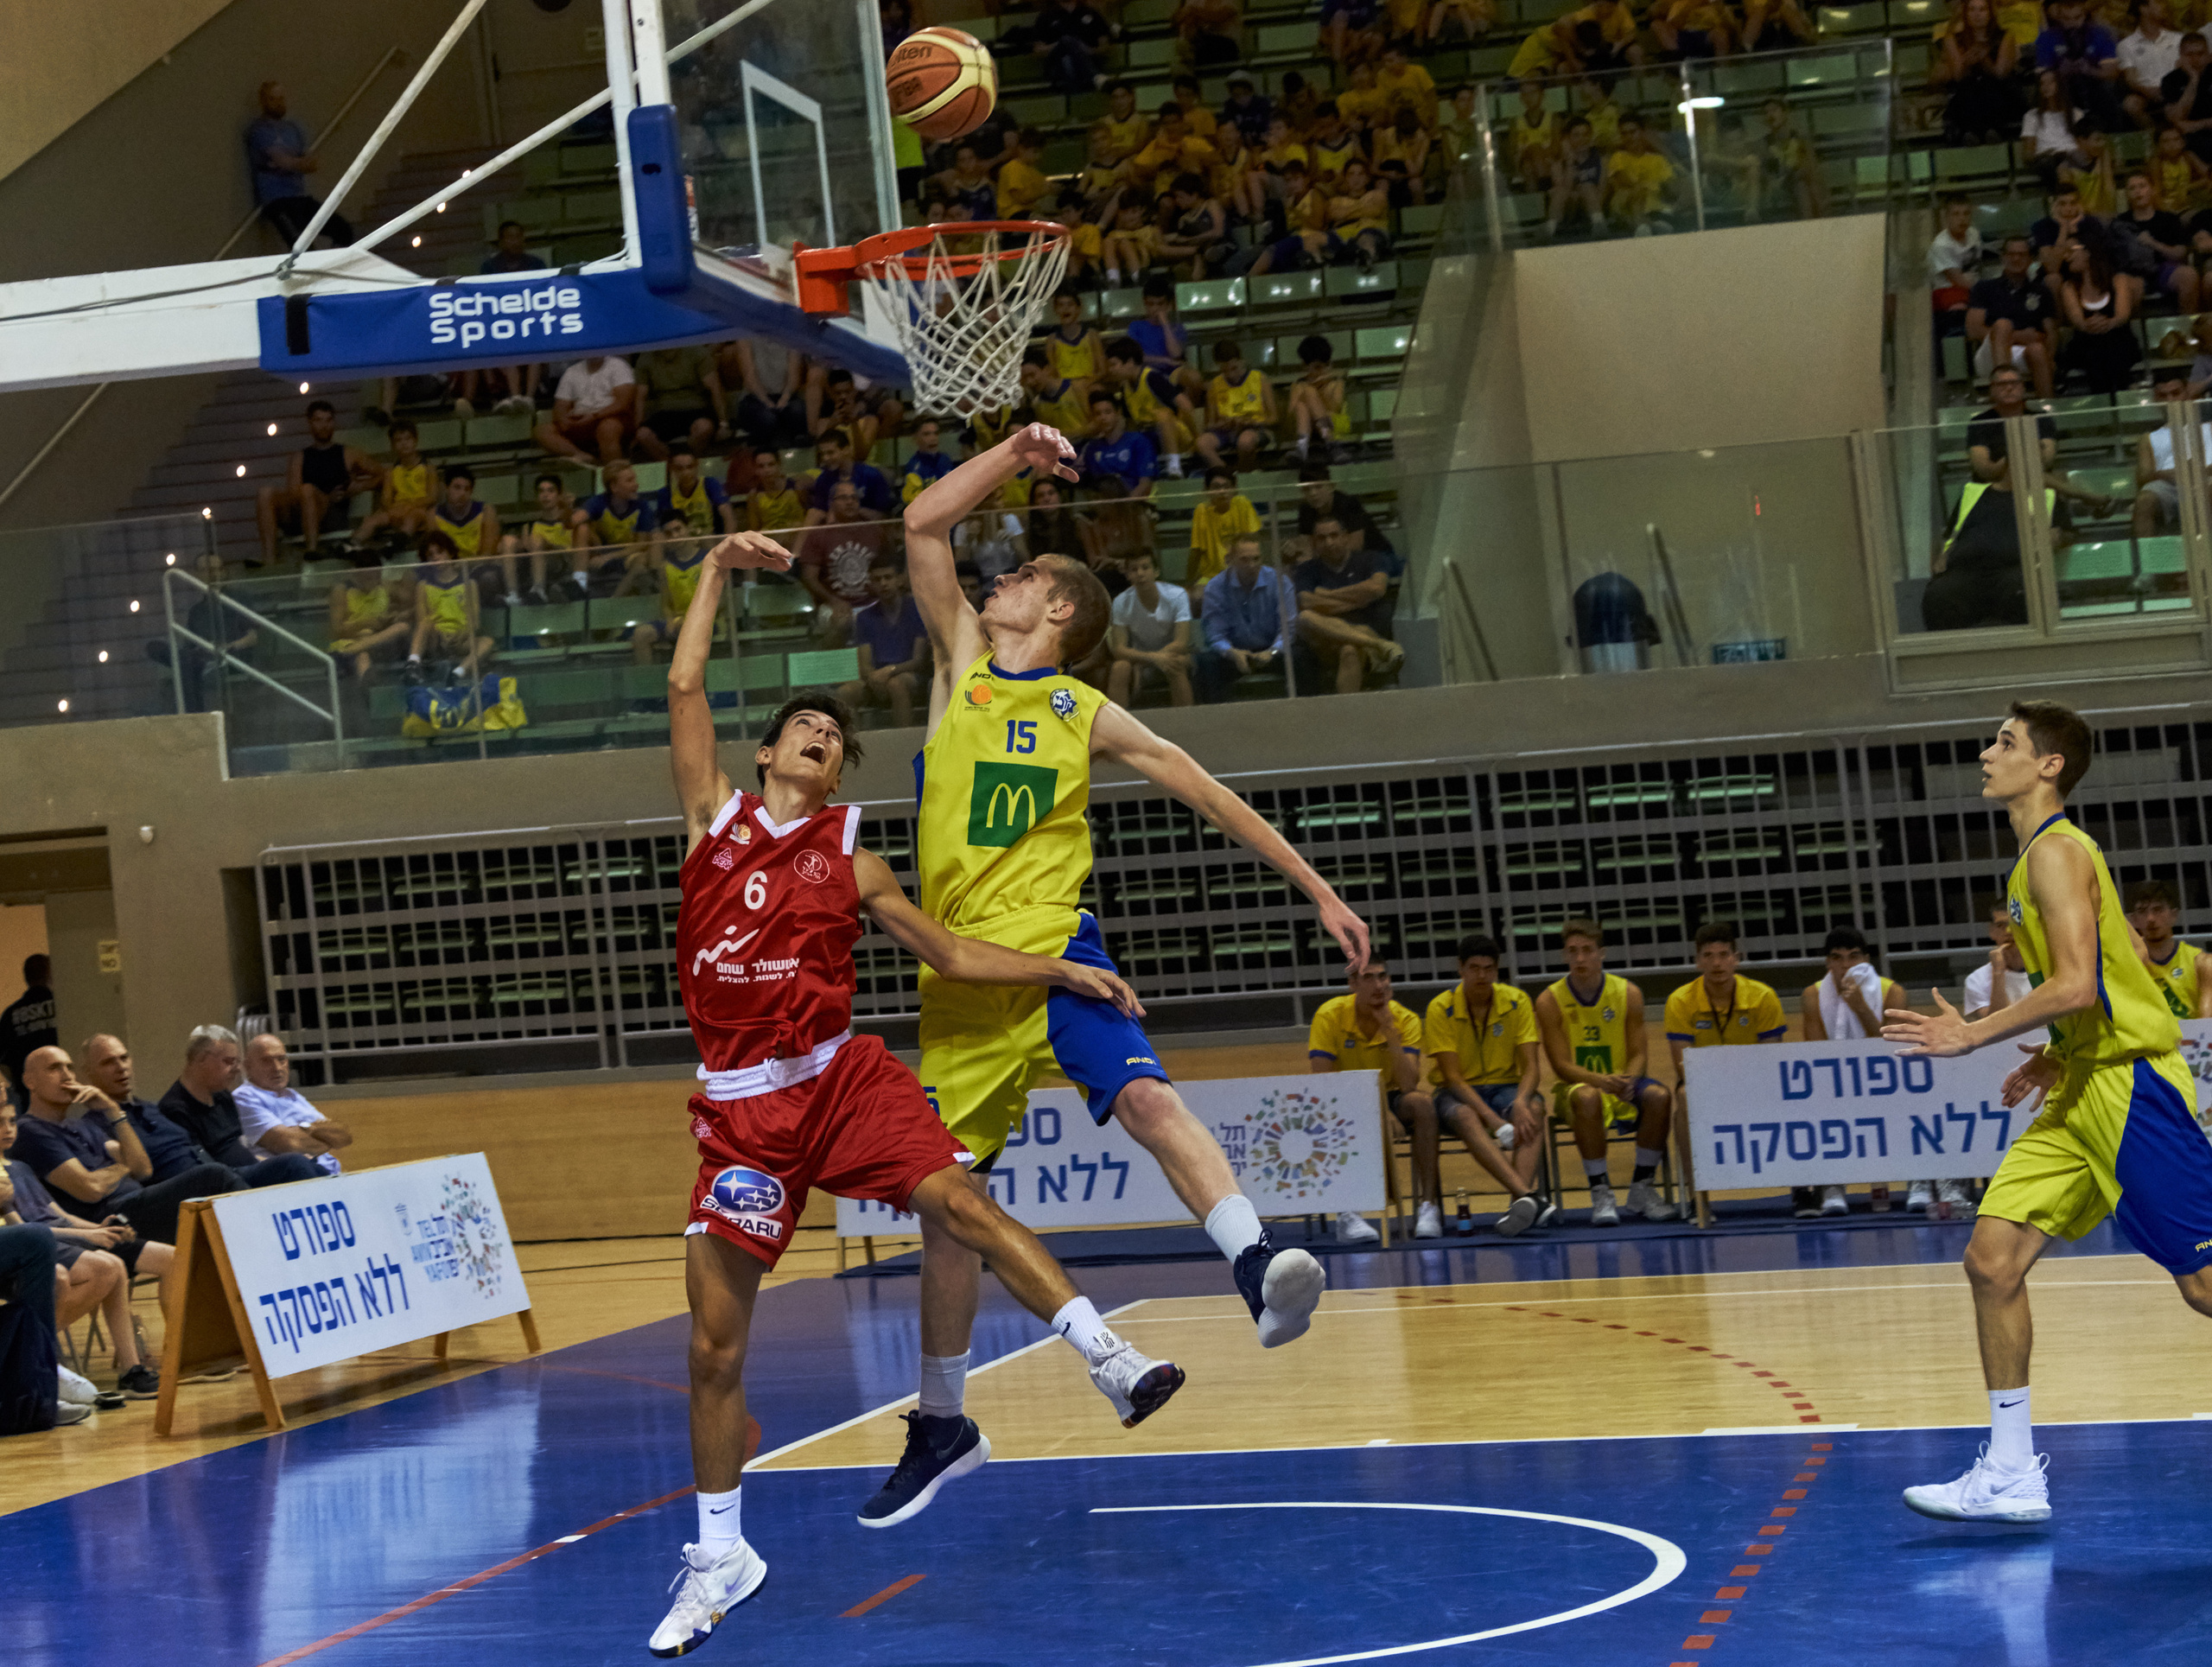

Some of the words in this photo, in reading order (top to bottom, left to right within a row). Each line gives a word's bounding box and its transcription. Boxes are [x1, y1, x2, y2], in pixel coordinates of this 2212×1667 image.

[429, 285, 582, 319] Schelde
[429, 311, 584, 349] Sports
[1006, 719, 1038, 754] 15
[744, 870, 768, 910] 6
[716, 962, 745, 975] שחם
[1778, 1054, 1935, 1101] ספורט
[1219, 1123, 1246, 1142] תל
[1712, 1116, 1889, 1174] הפסקה
[1909, 1100, 2012, 1156] ללא
[1038, 1151, 1129, 1204] ללא
[271, 1199, 356, 1261] ספורט
[353, 1253, 410, 1320] ללא
[259, 1276, 358, 1354] הפסקה
